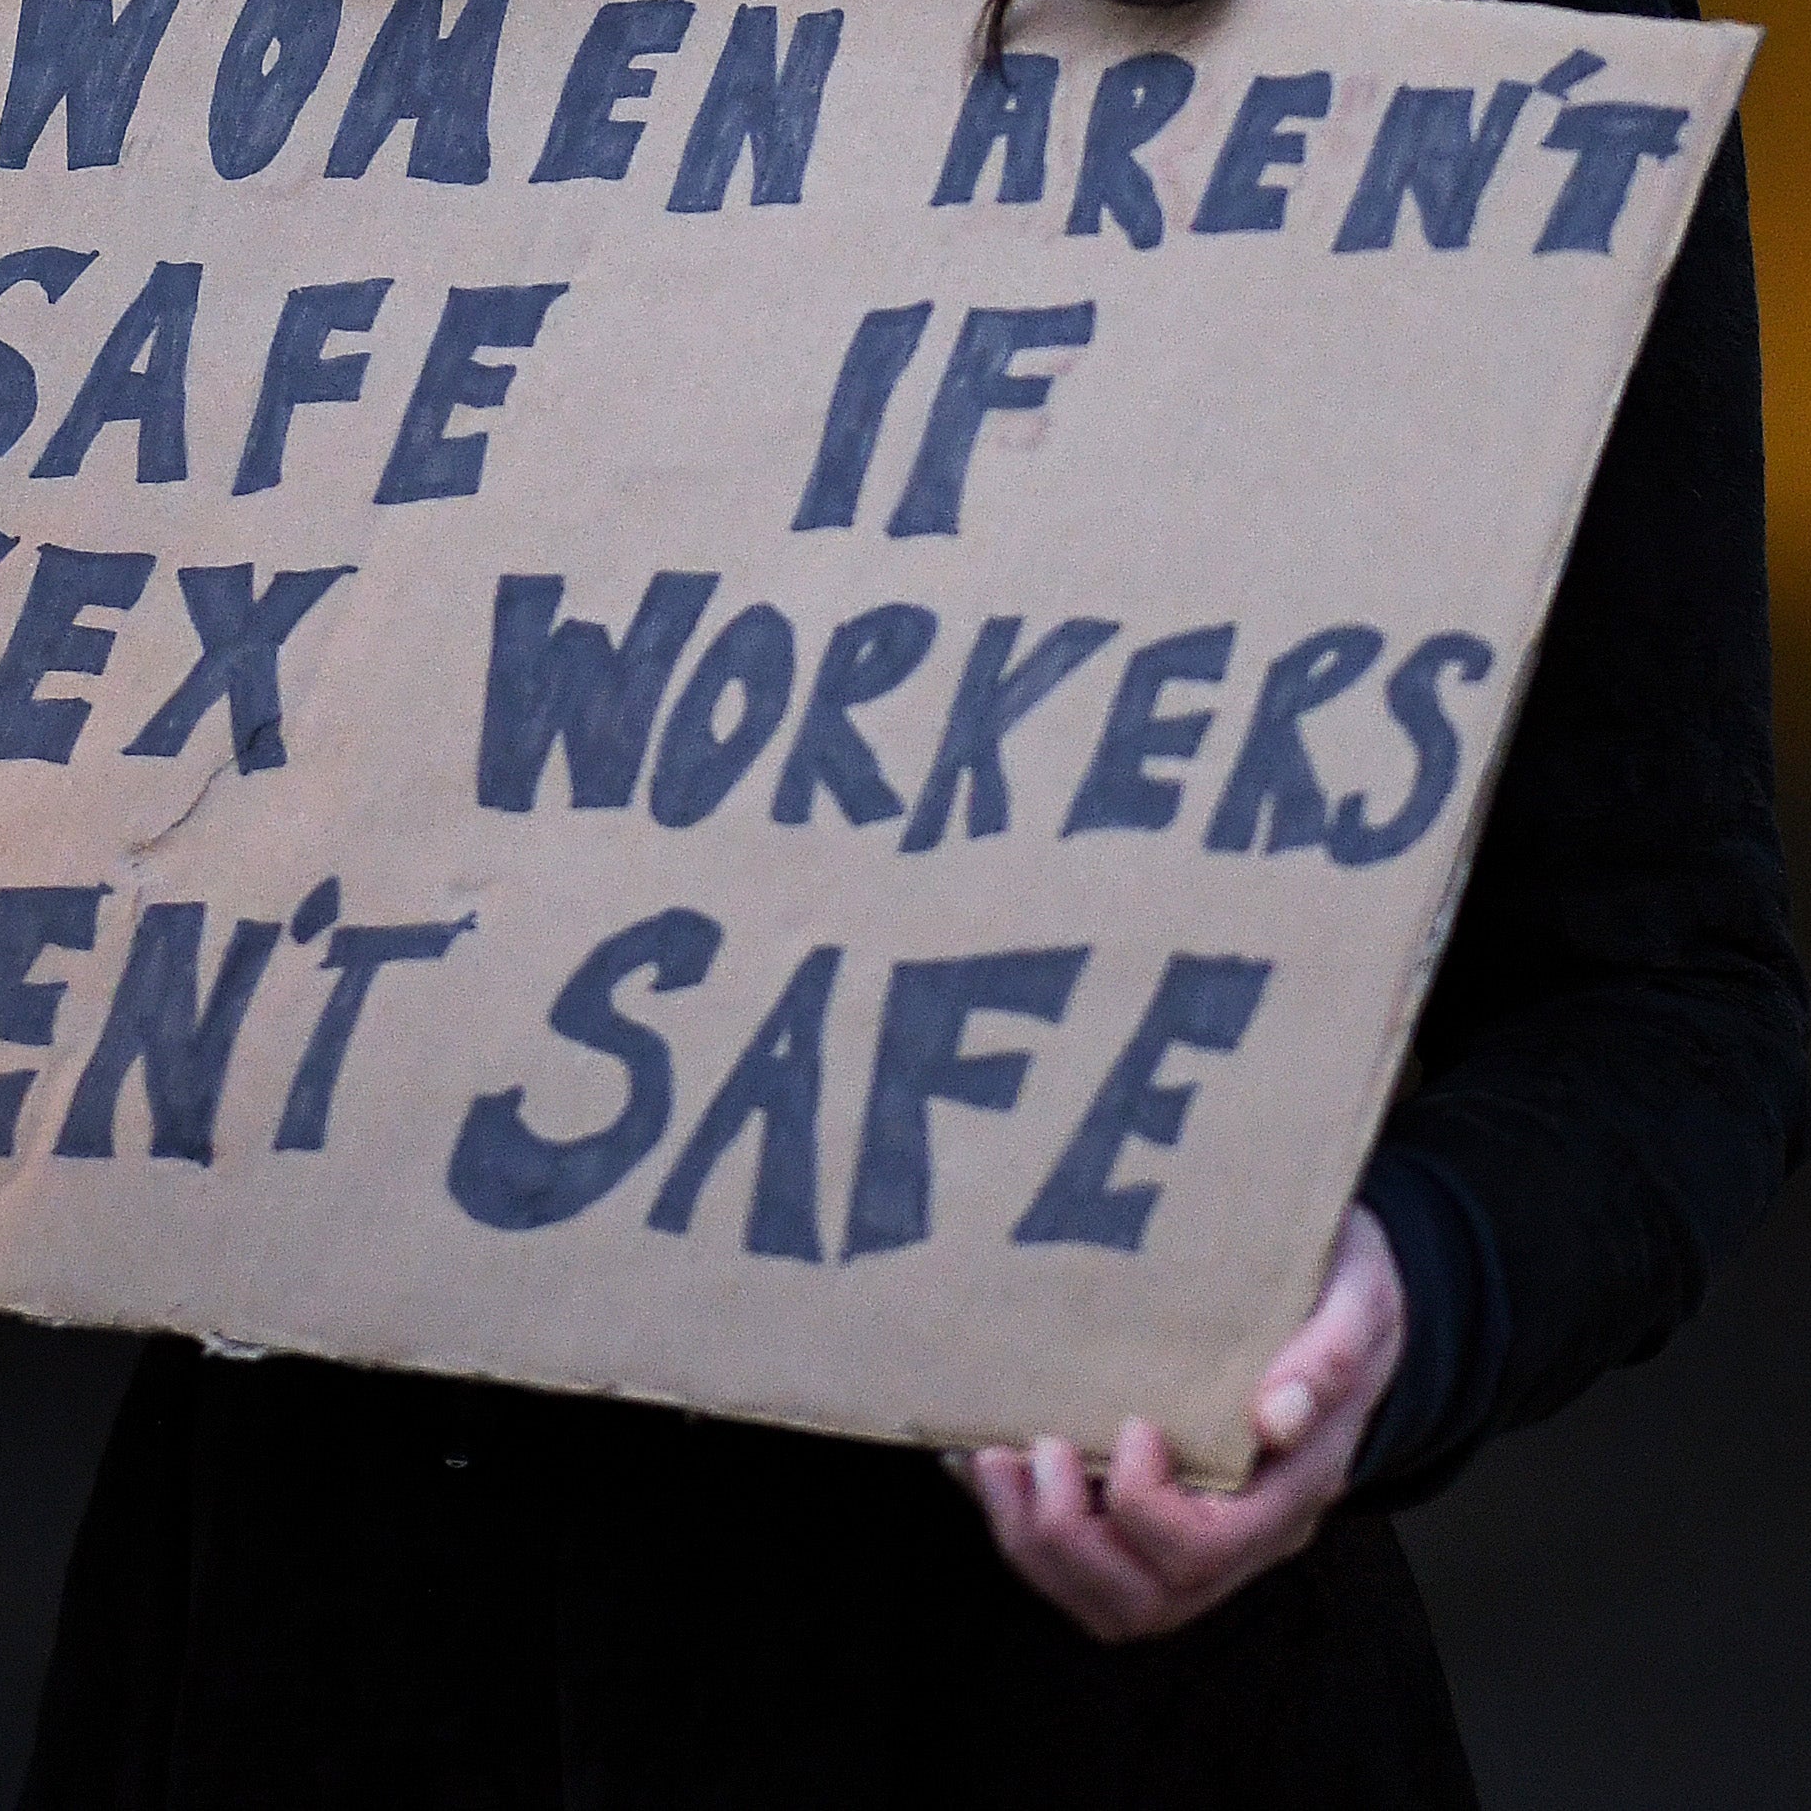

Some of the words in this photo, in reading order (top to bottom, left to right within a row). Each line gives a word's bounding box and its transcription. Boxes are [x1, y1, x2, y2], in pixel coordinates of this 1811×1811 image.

[928, 48, 1691, 256] AREN'T
[790, 300, 1097, 540] IF
[475, 570, 1497, 871] WORKERS
[443, 906, 1274, 1269] SAFE
